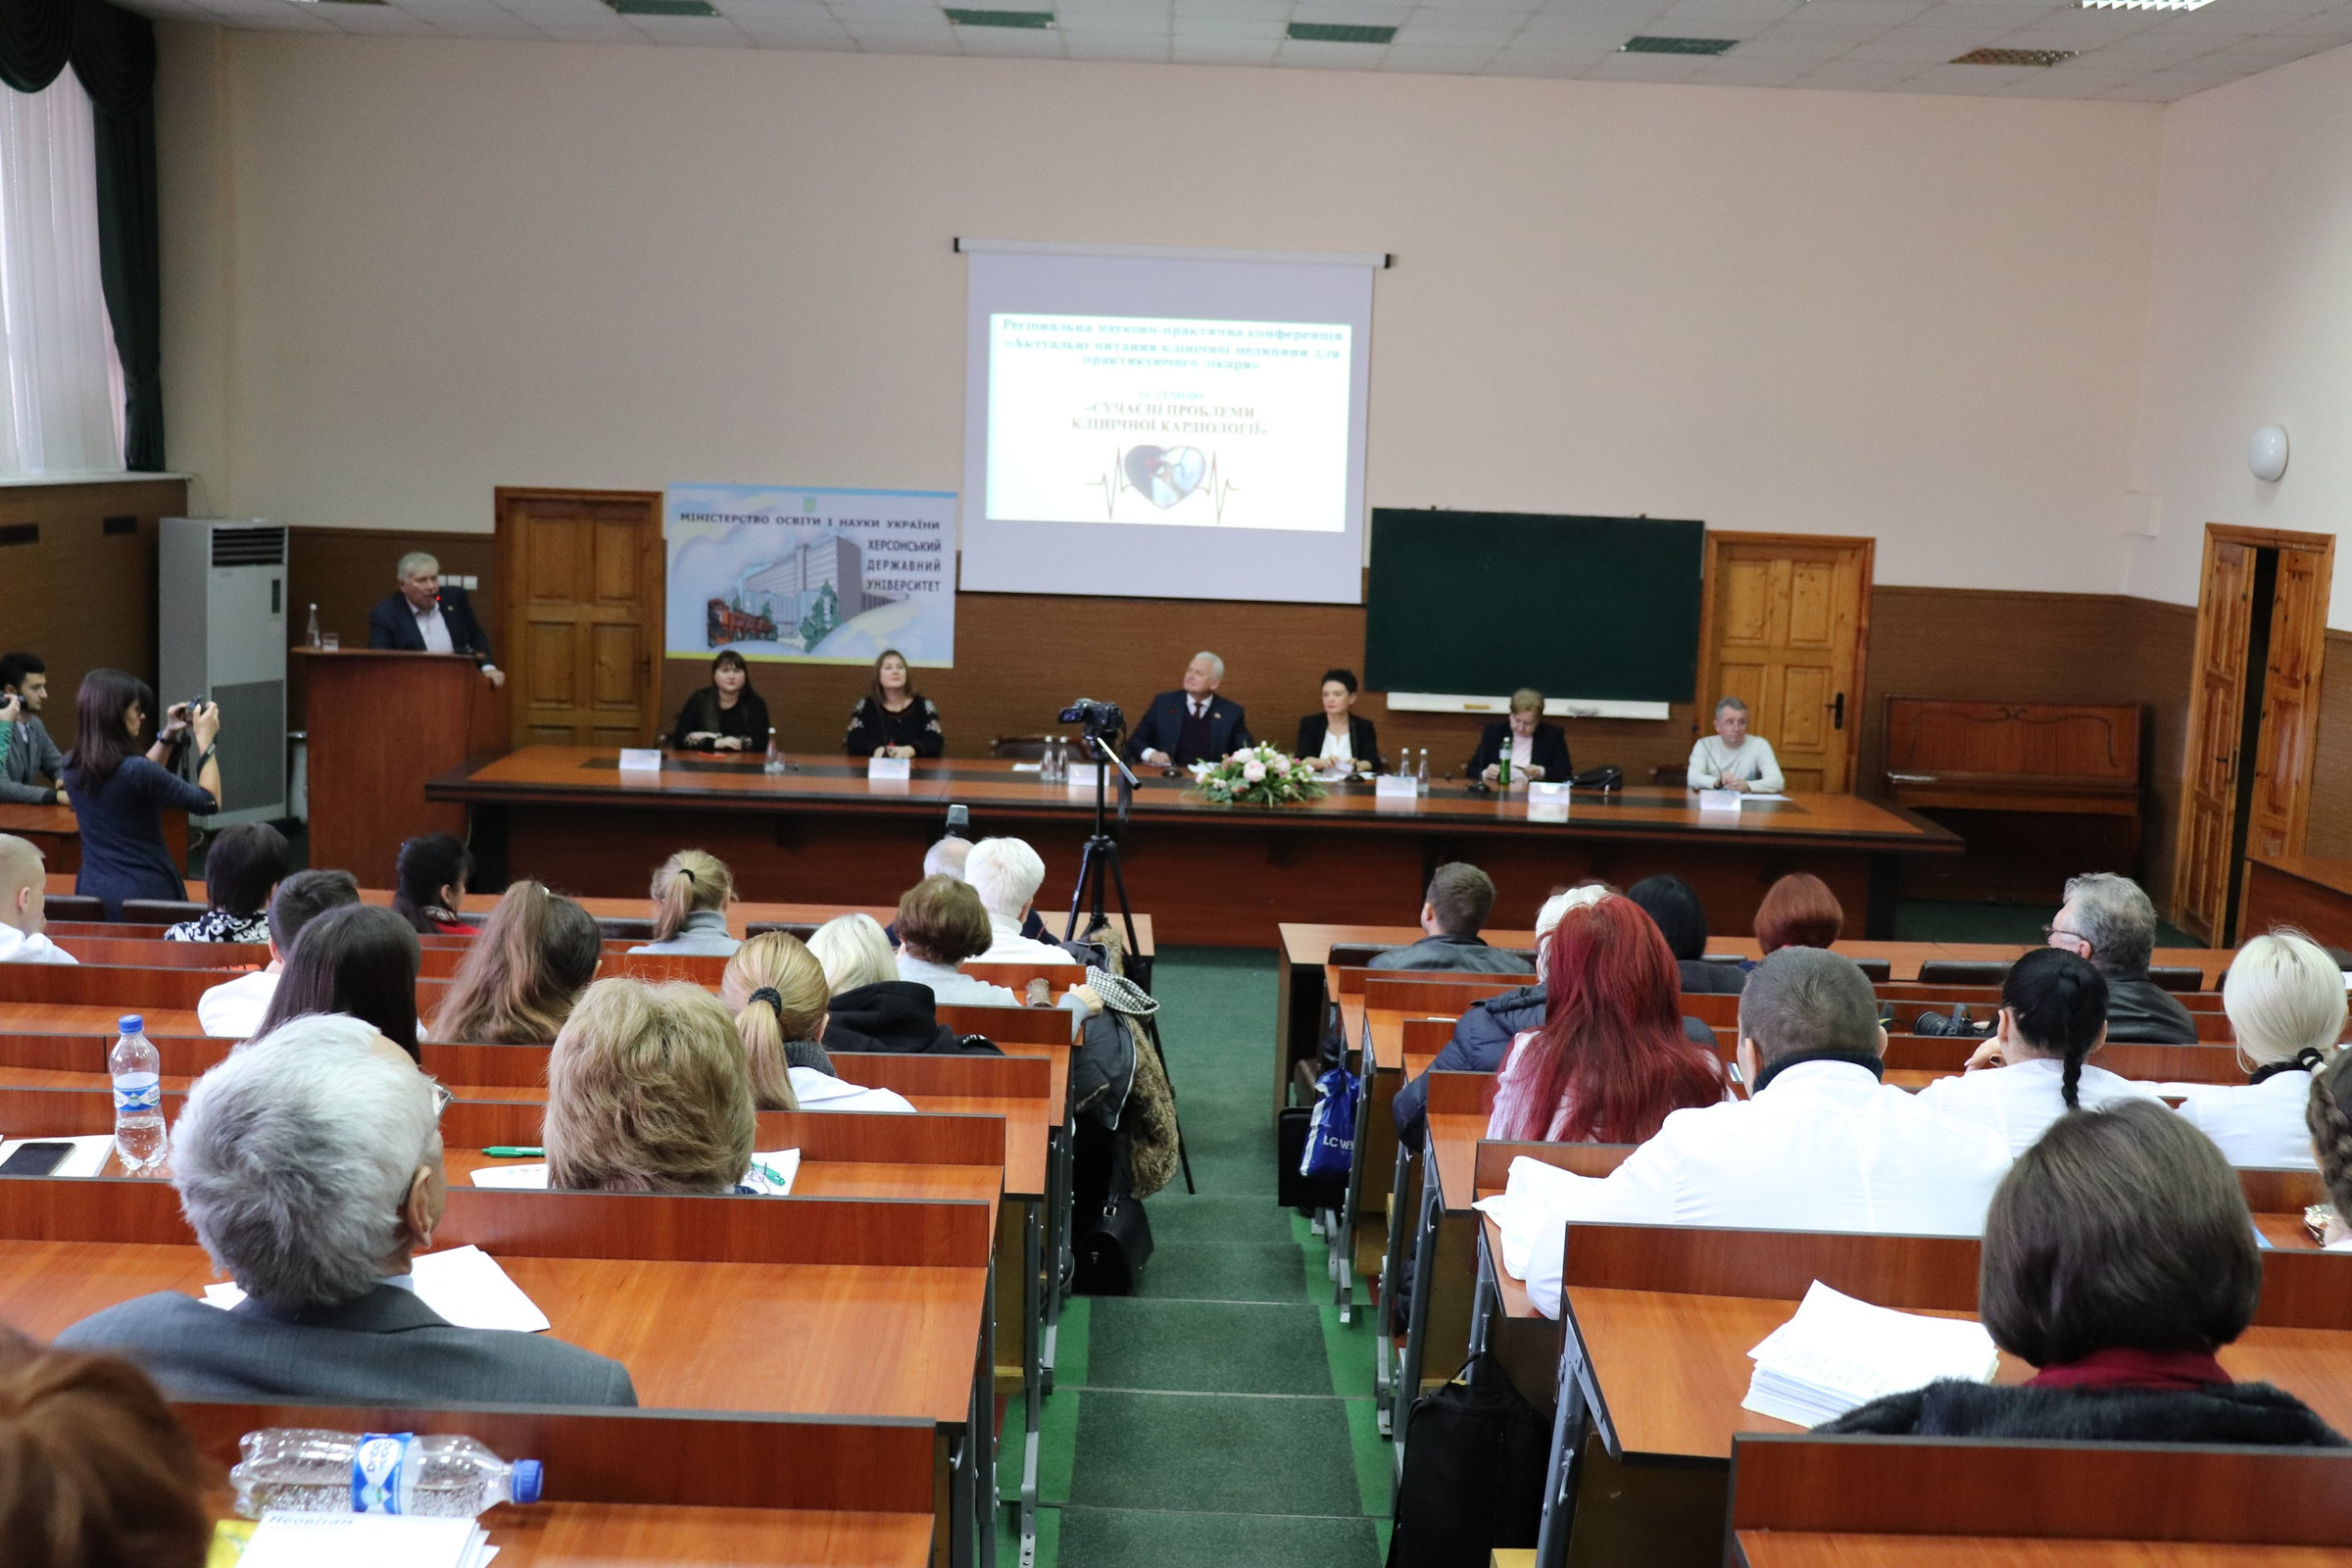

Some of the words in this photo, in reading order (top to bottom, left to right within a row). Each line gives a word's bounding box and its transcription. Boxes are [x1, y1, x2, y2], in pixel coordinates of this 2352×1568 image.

[1248, 327, 1344, 343] конференція
[1083, 402, 1163, 416] «СУЧАСНІ
[1167, 404, 1255, 418] ПРОБЛЕМИ
[1071, 416, 1156, 431] КЛІНІЧНОЇ
[680, 513, 769, 525] МІНІСТЕРСТВО
[776, 515, 821, 526] ОСВІТИ
[839, 518, 880, 529] НАУКИ
[886, 518, 941, 530] УКРАЇНИ
[867, 538, 942, 552] ХЕРСОНСЬКИЙ
[866, 559, 942, 572] ДЕРЖАВНИЙ
[866, 579, 941, 593] УНІВЕРСИТЕТ
[1323, 1135, 1339, 1148] LC
